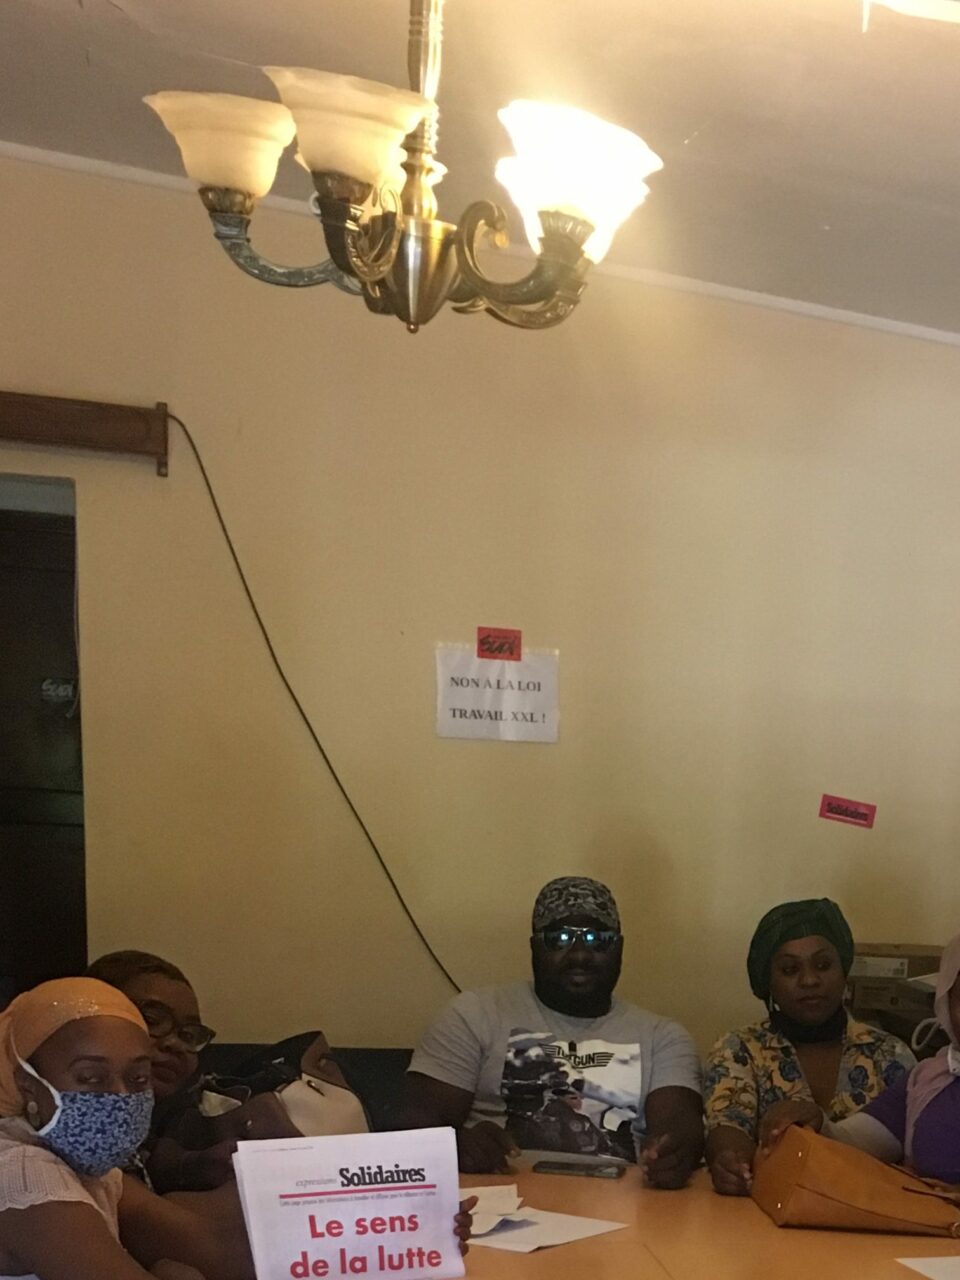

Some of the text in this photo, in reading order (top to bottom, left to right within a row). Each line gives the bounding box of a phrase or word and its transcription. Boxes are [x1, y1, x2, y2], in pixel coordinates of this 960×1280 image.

[450, 676, 480, 689] NON
[496, 679, 515, 690] LA
[517, 680, 541, 692] LOI
[449, 708, 507, 721] TRAVAIL
[511, 711, 538, 723] XXL
[573, 1053, 596, 1067] GUN
[339, 1164, 426, 1188] Solidaires
[308, 1213, 419, 1239] Le sens
[290, 1245, 442, 1279] de la lutte
